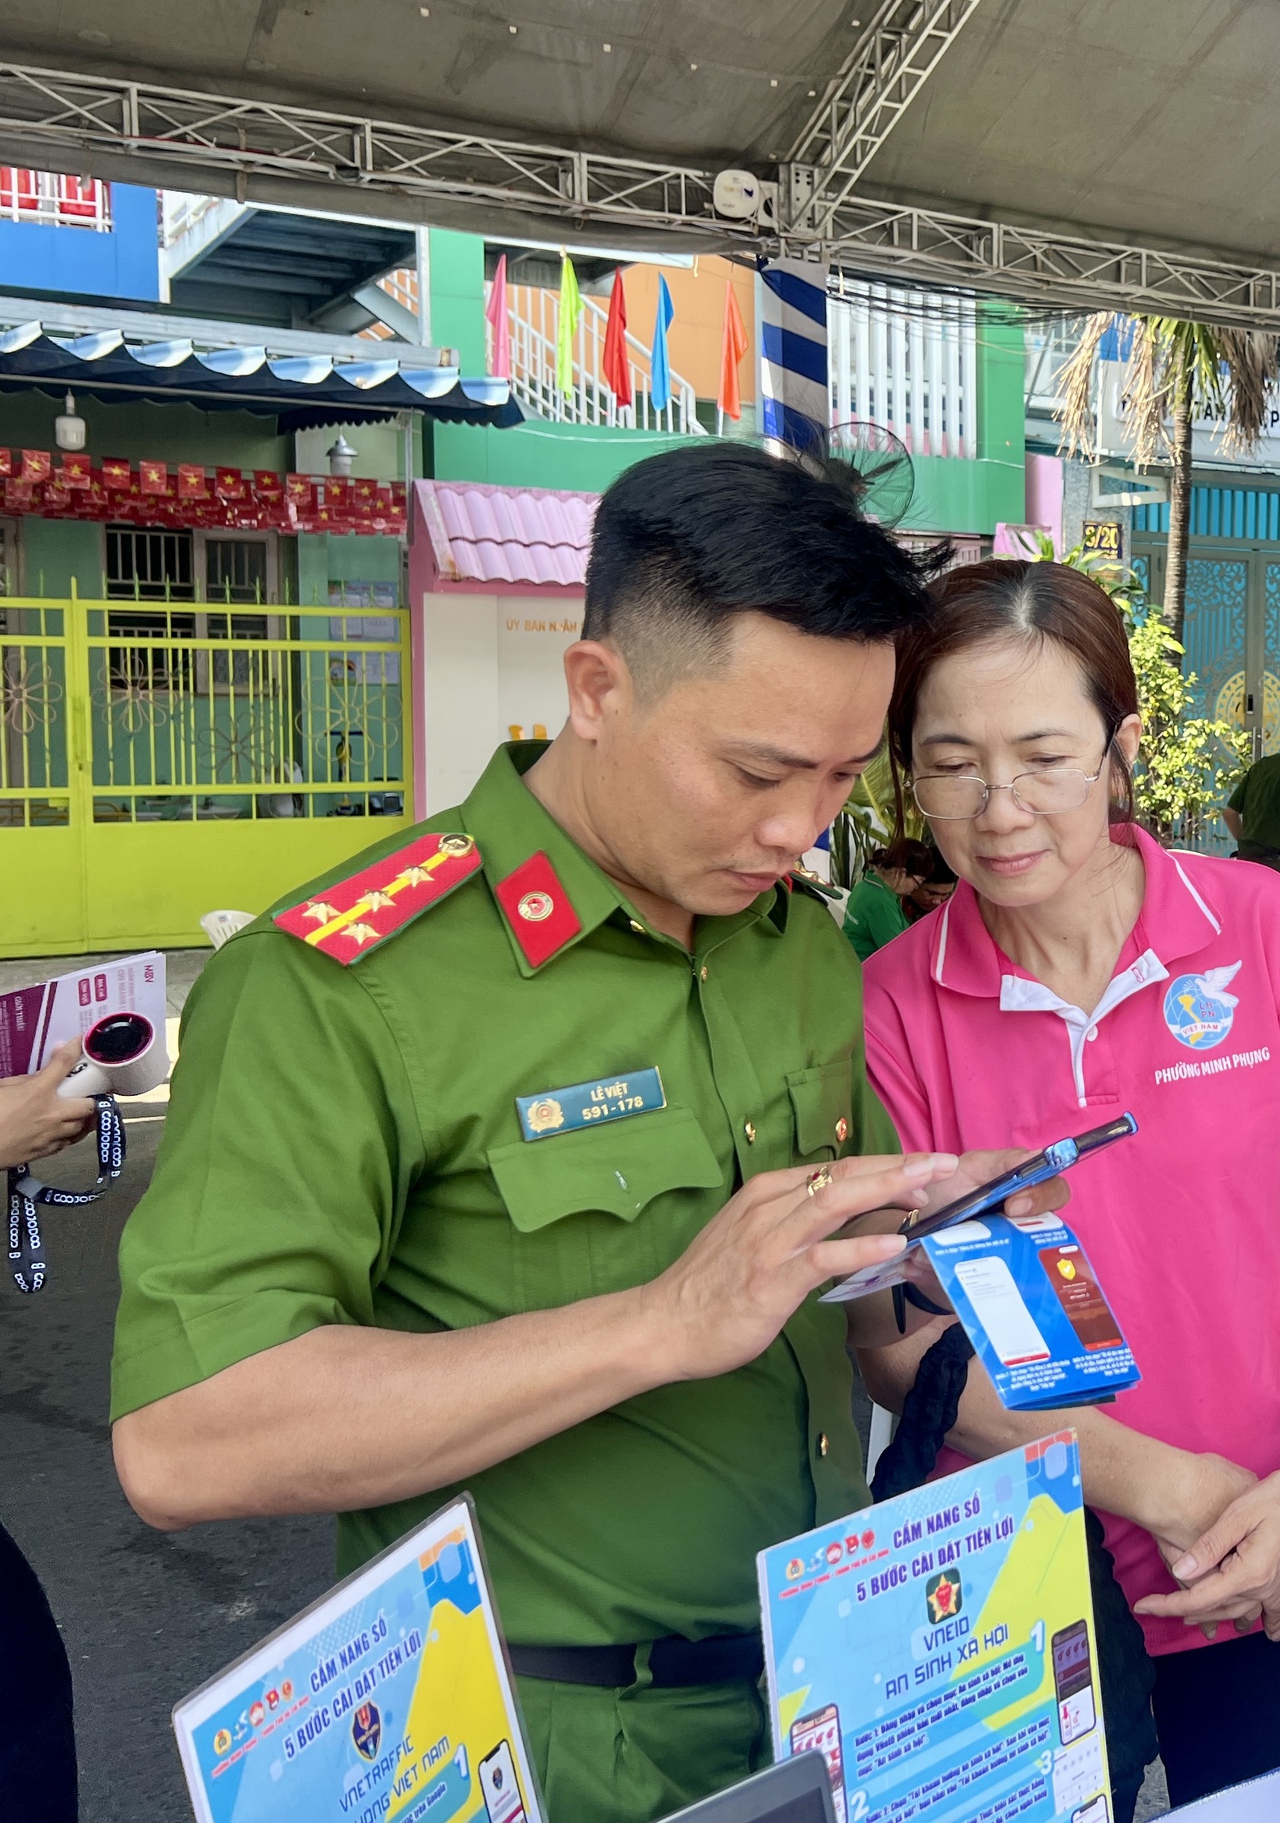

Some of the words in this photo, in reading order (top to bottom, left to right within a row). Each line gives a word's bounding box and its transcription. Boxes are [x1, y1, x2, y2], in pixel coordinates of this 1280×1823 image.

[1154, 1061, 1200, 1085] PHƯỜNG
[1201, 1056, 1232, 1076] MINH
[1232, 1046, 1270, 1068] PHỤNG
[590, 1085, 605, 1102] LÊ
[927, 1504, 960, 1535] NANG
[964, 1489, 980, 1518] SỐ
[857, 1581, 866, 1601] 5
[871, 1562, 907, 1596] BƯỚC
[912, 1552, 934, 1577] CÀI
[938, 1540, 962, 1565] ĐẶT
[965, 1526, 991, 1553] TIỆN
[995, 1514, 1014, 1541] LỢI
[339, 1632, 370, 1670] NANG
[371, 1611, 387, 1643] SỐ
[1030, 1619, 1045, 1654] 1
[914, 1651, 952, 1686] SINH
[284, 1737, 295, 1759] 5
[297, 1706, 331, 1749] BƯỚC
[332, 1686, 354, 1718] CÀI
[354, 1667, 377, 1699] ĐẶT
[378, 1645, 403, 1679] TIỆN
[403, 1630, 421, 1658] LỢI
[422, 1736, 450, 1772] NAM
[1040, 1749, 1052, 1776] 3
[850, 1790, 870, 1822] 2
